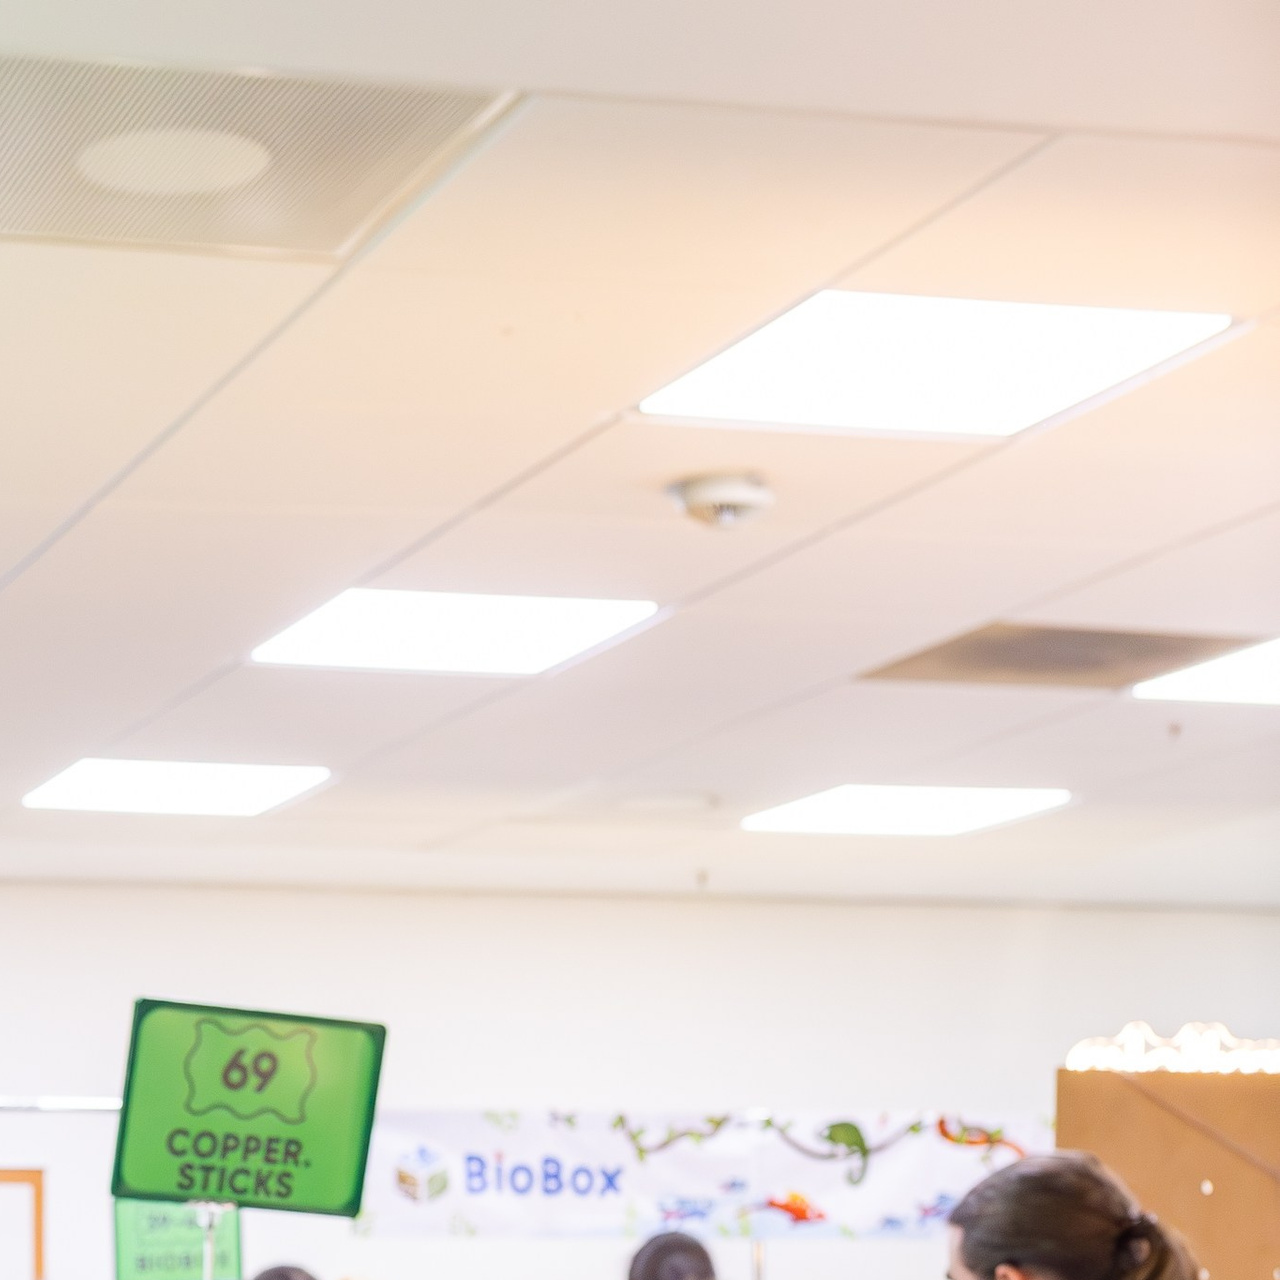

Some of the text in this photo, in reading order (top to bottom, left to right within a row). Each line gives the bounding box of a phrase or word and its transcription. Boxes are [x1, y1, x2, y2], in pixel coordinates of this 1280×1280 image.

[221, 1047, 279, 1093] 69
[176, 1162, 295, 1199] STICKS
[464, 1148, 623, 1196] BioBox
